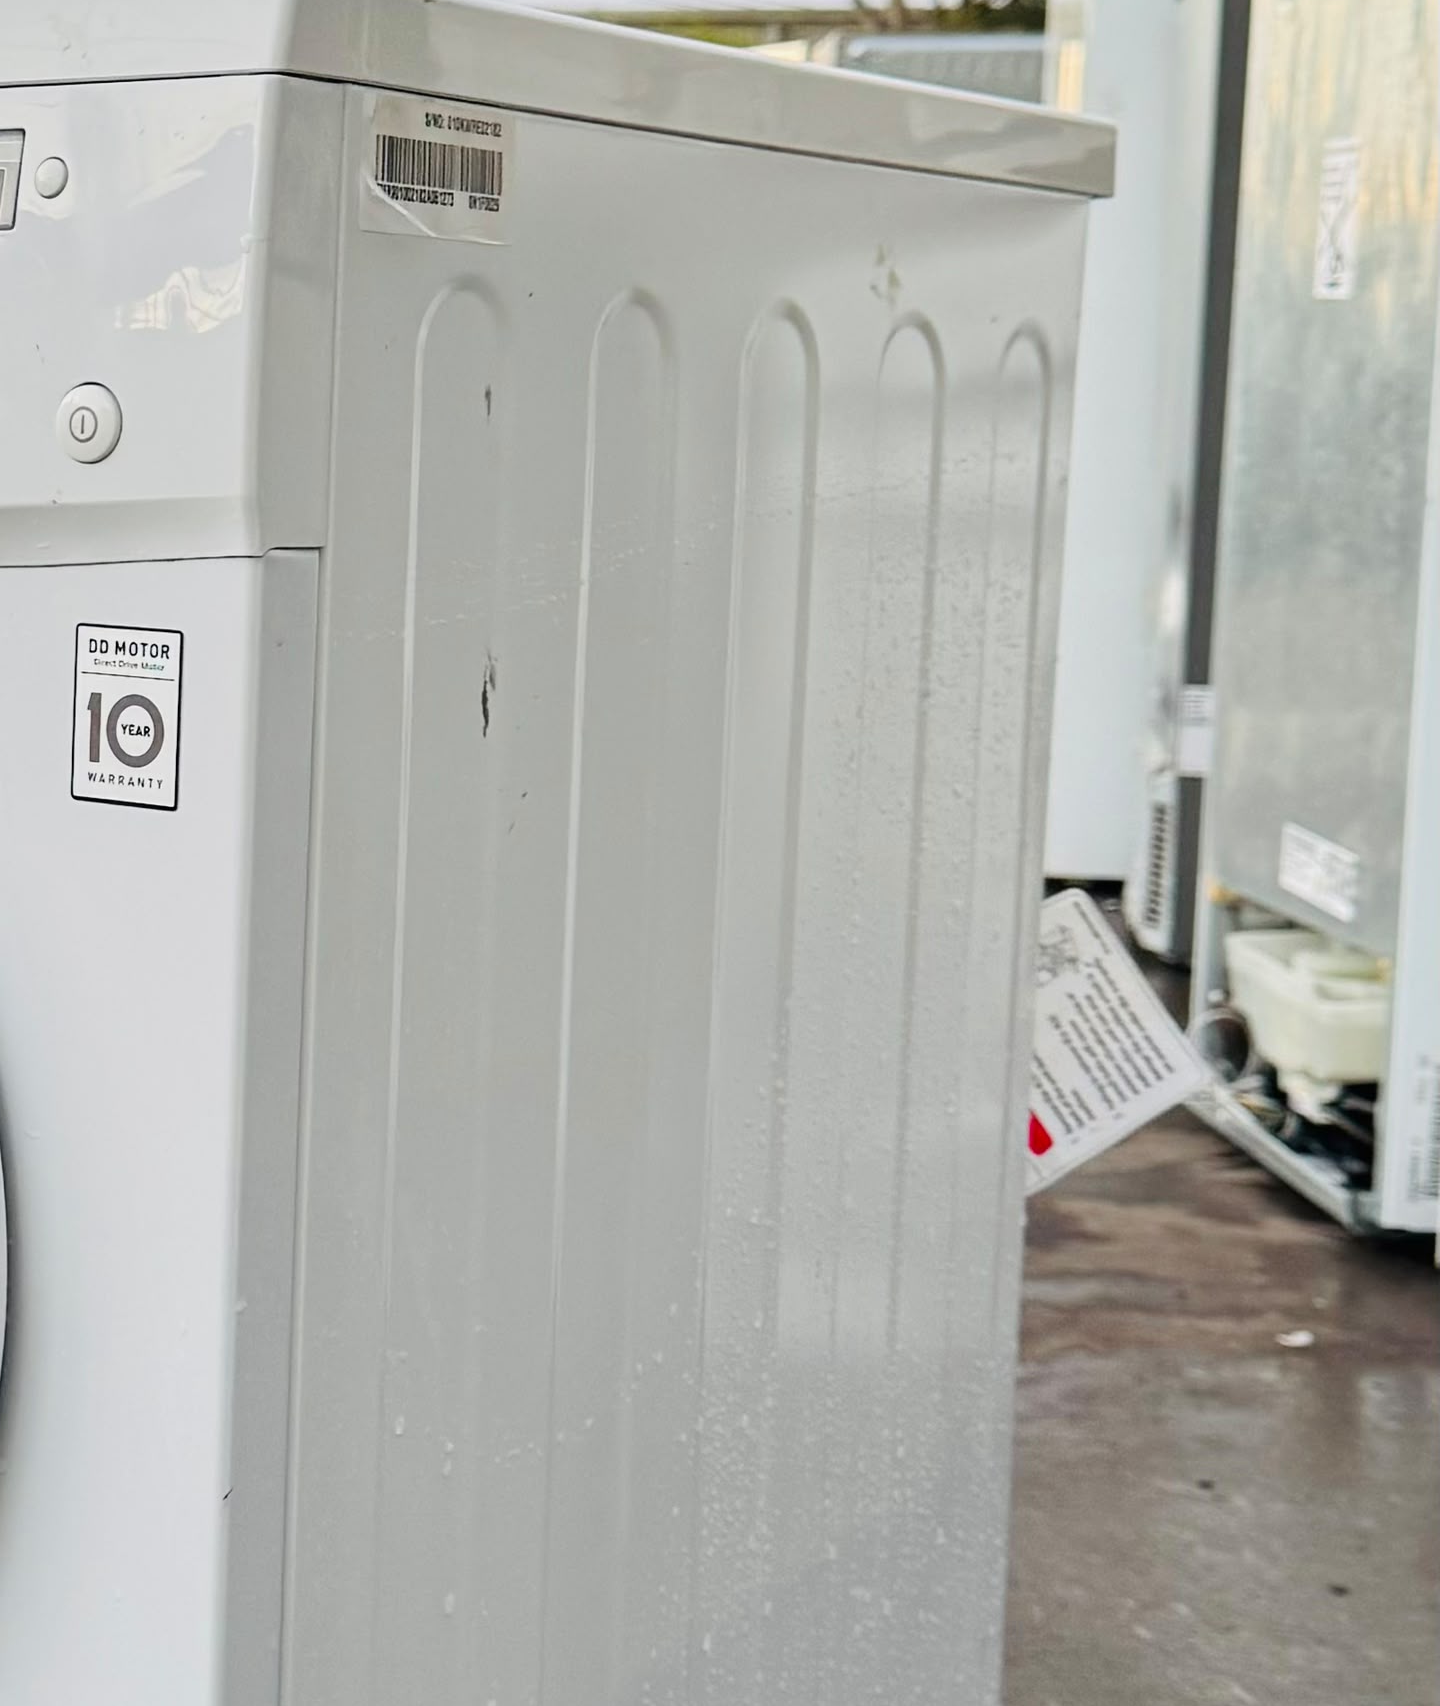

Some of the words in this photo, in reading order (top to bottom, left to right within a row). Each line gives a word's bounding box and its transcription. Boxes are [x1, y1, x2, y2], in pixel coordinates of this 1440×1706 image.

[89, 638, 109, 654] DD
[115, 640, 170, 660] MOTOR
[87, 692, 165, 768] 10
[121, 723, 151, 737] YEAR
[87, 772, 163, 789] WARRANTY
